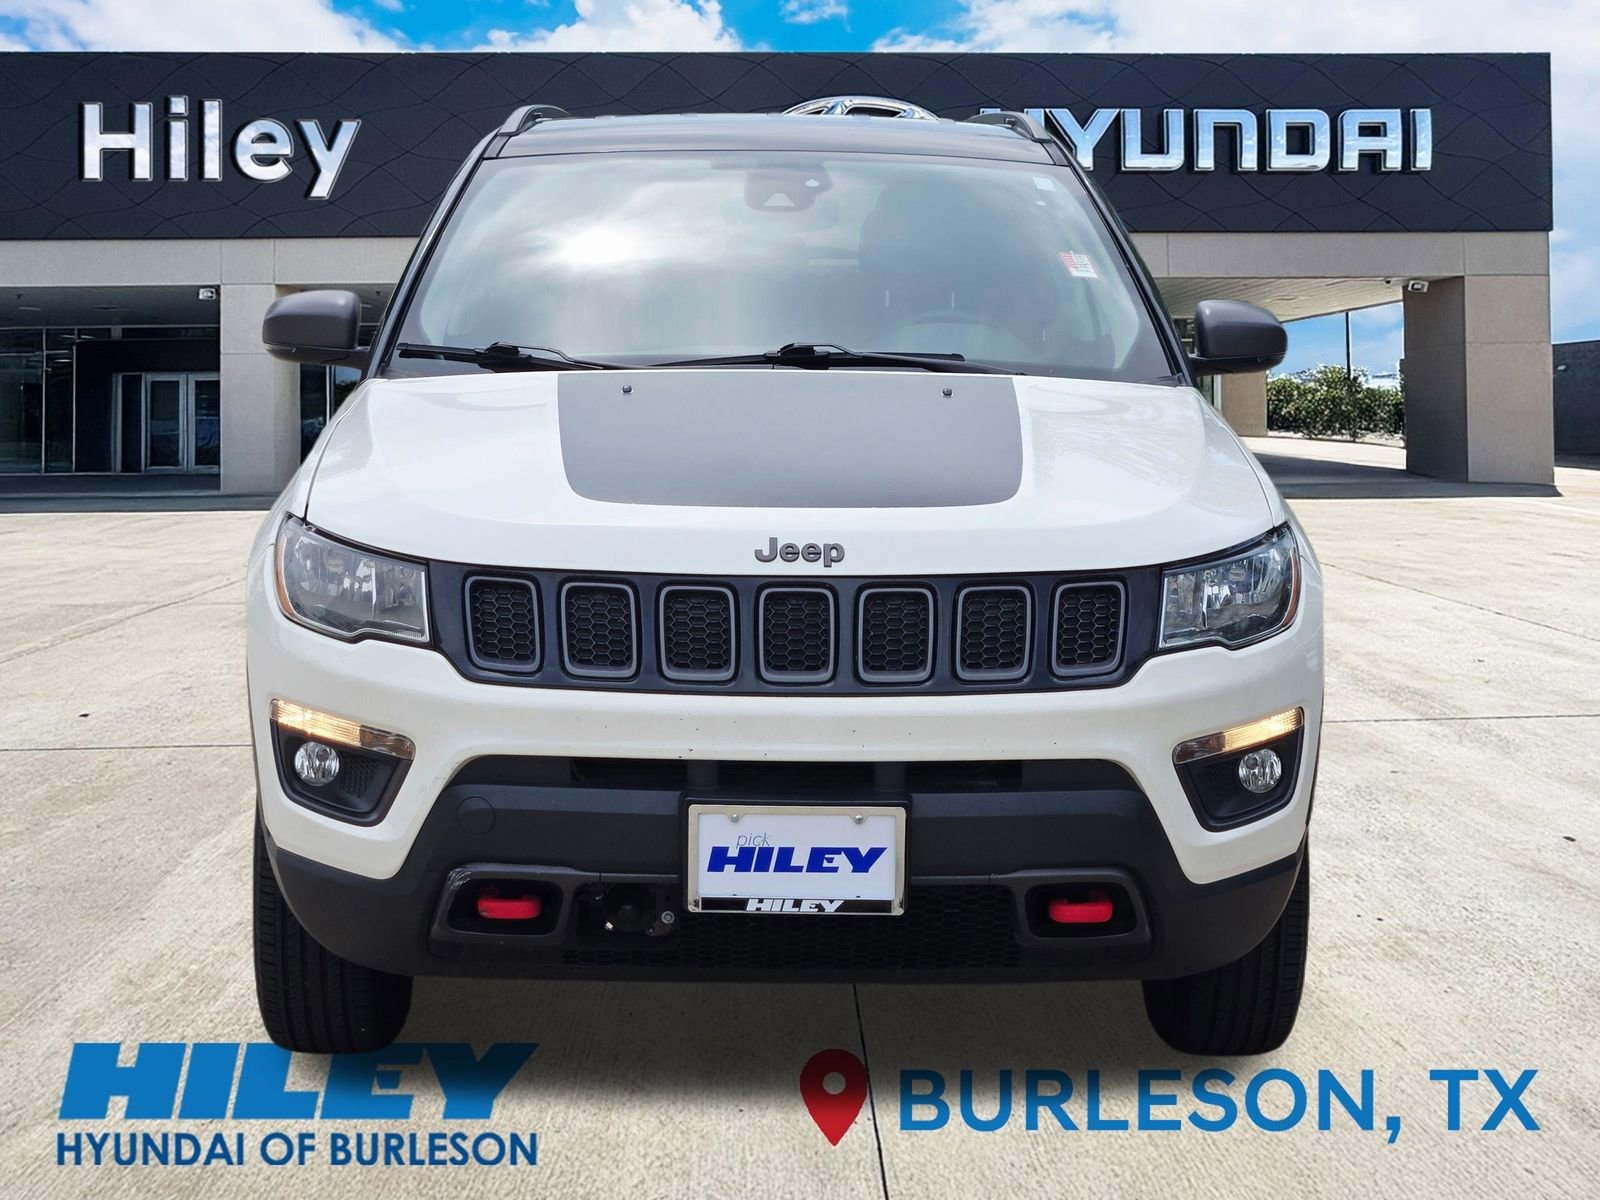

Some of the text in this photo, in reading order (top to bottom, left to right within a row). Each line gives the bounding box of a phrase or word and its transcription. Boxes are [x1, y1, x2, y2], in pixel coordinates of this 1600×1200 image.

[79, 95, 361, 199] Hiley
[980, 108, 1432, 172] YUNDAI
[754, 537, 845, 568] Jeep
[736, 833, 770, 848] pick
[707, 846, 888, 873] HILEY
[746, 899, 845, 912] HILEY
